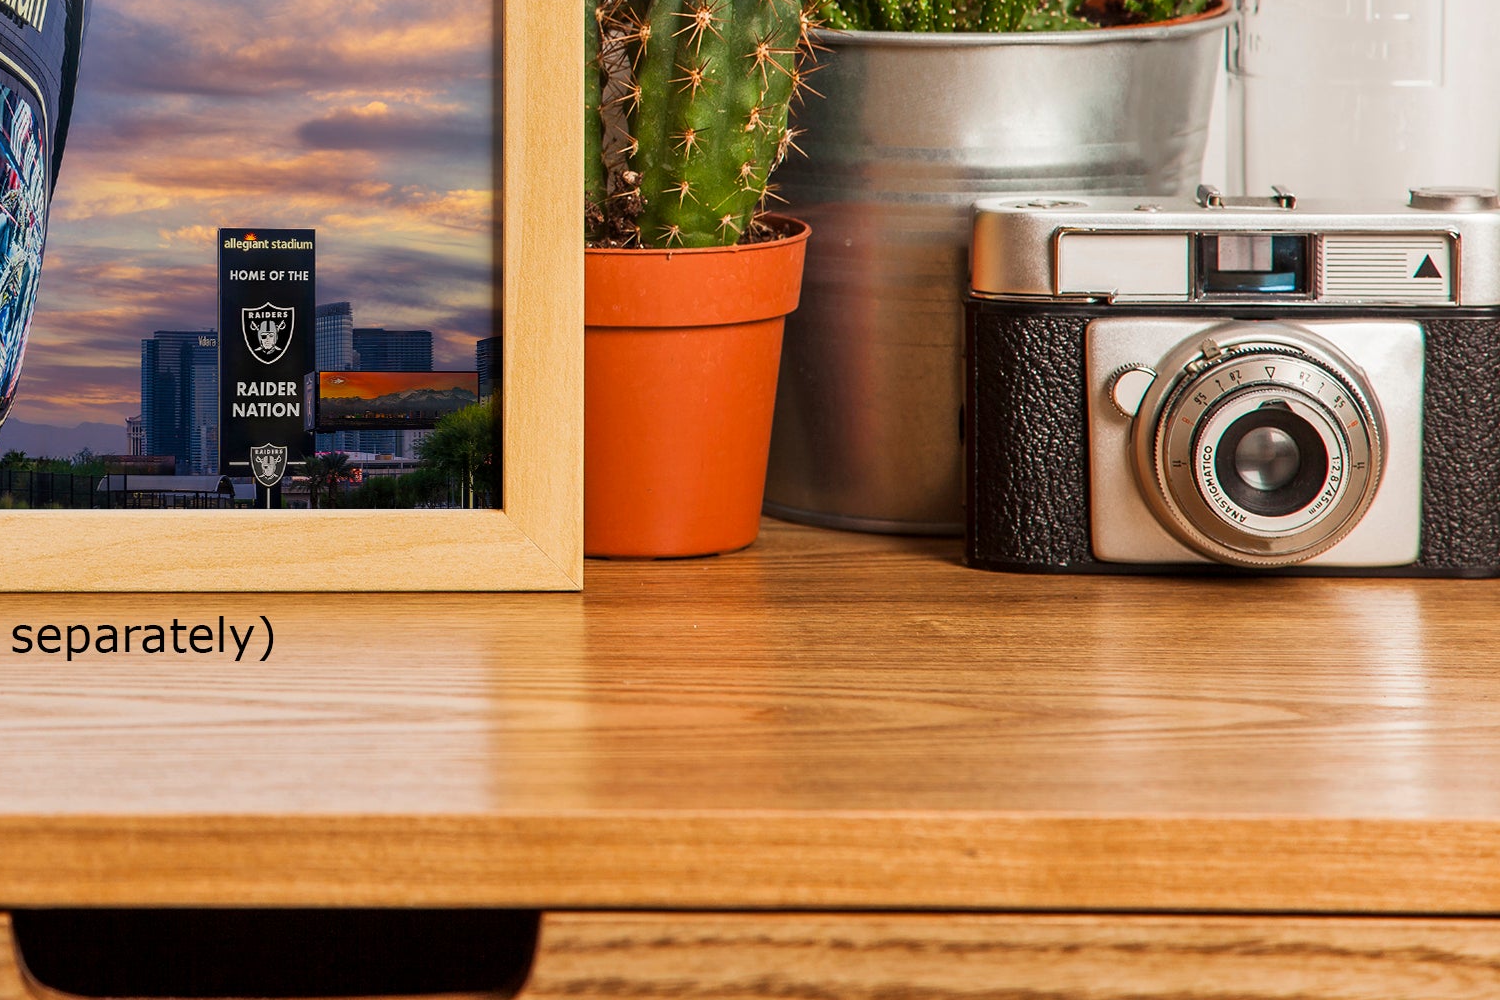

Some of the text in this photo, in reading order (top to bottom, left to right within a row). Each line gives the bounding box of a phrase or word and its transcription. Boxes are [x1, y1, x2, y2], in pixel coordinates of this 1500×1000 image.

[224, 238, 313, 252] allegiant stadium
[230, 269, 309, 281] HOME OF THE
[248, 311, 288, 319] RAIDERS
[237, 382, 297, 396] RAIDER
[232, 402, 300, 417] NATION
[1203, 446, 1247, 522] ANASTIGMATICO
